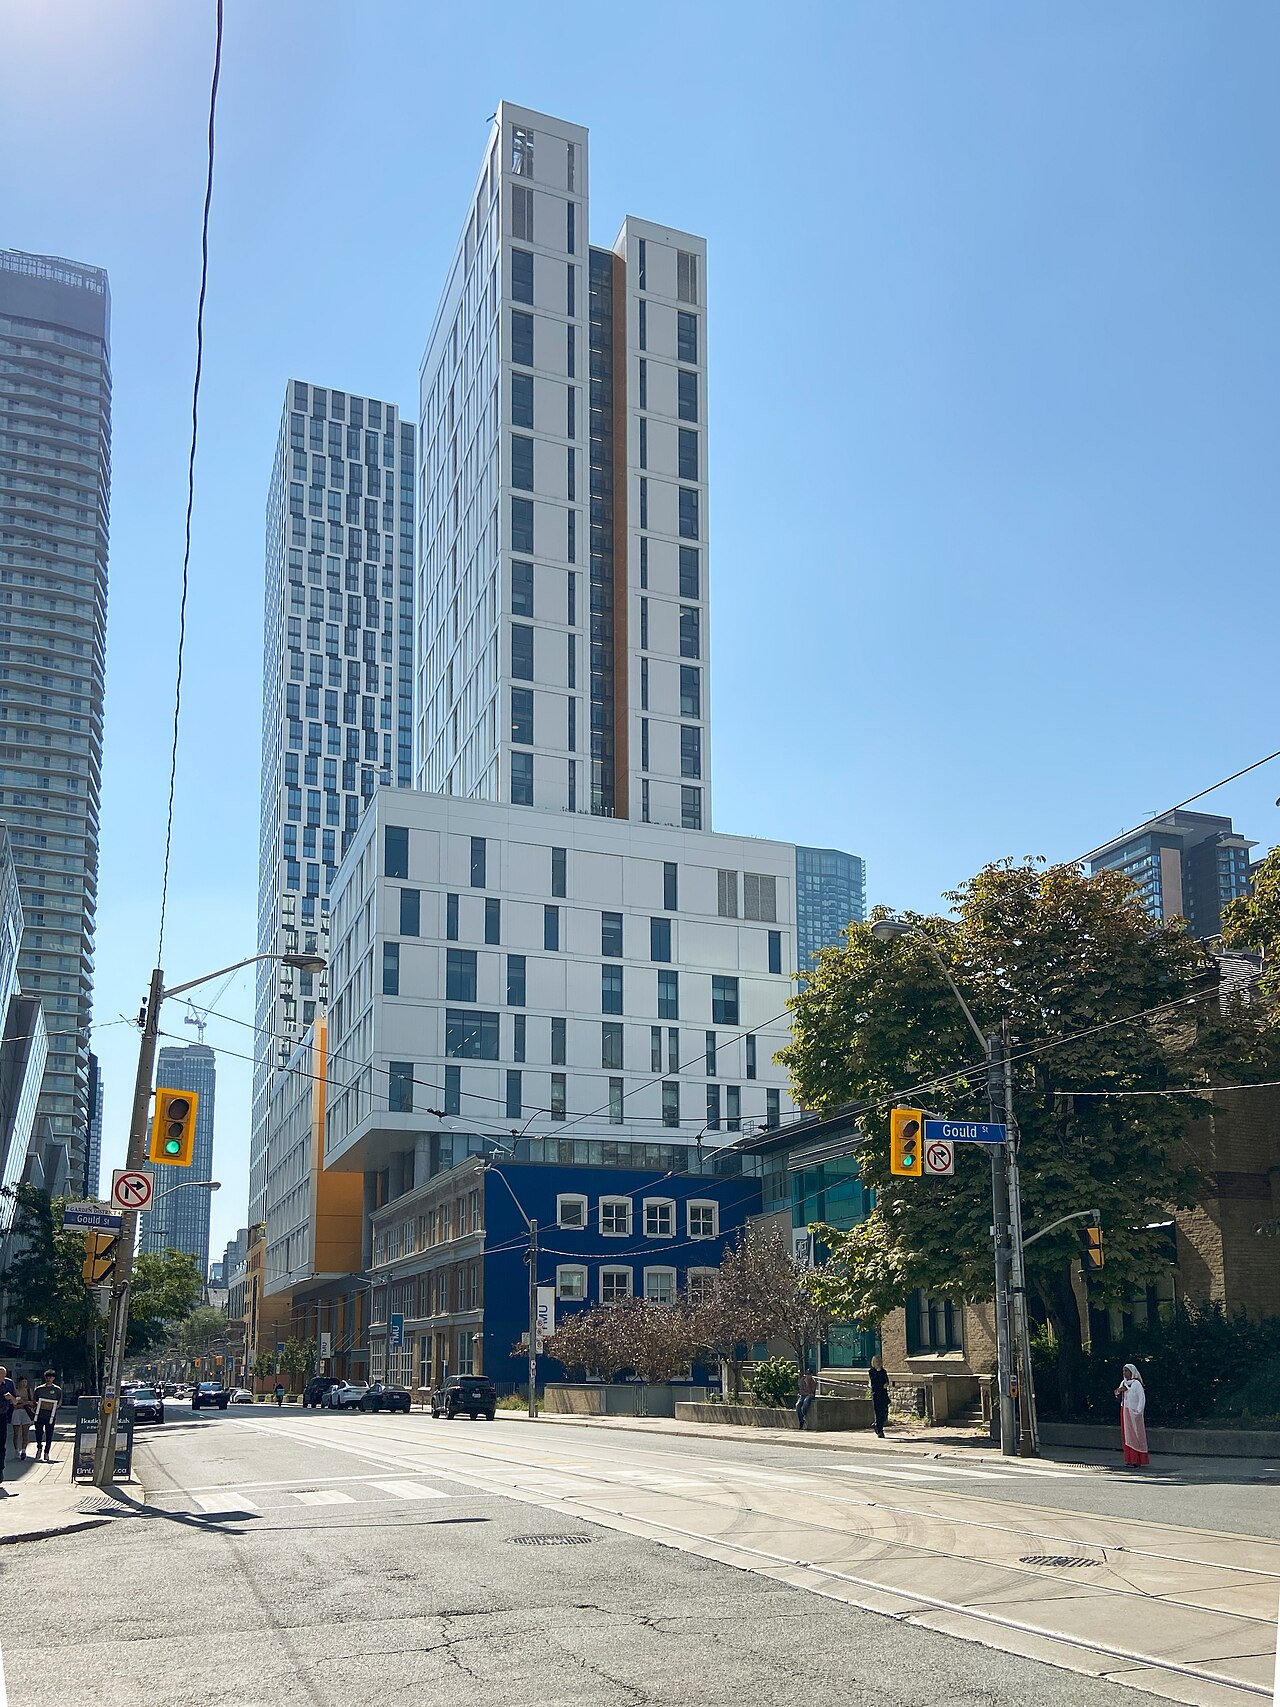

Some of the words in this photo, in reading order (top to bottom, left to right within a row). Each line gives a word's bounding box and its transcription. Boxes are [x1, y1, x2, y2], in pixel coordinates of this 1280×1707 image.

[942, 1124, 977, 1138] Gould
[981, 1125, 989, 1133] St
[77, 1214, 100, 1225] Gould
